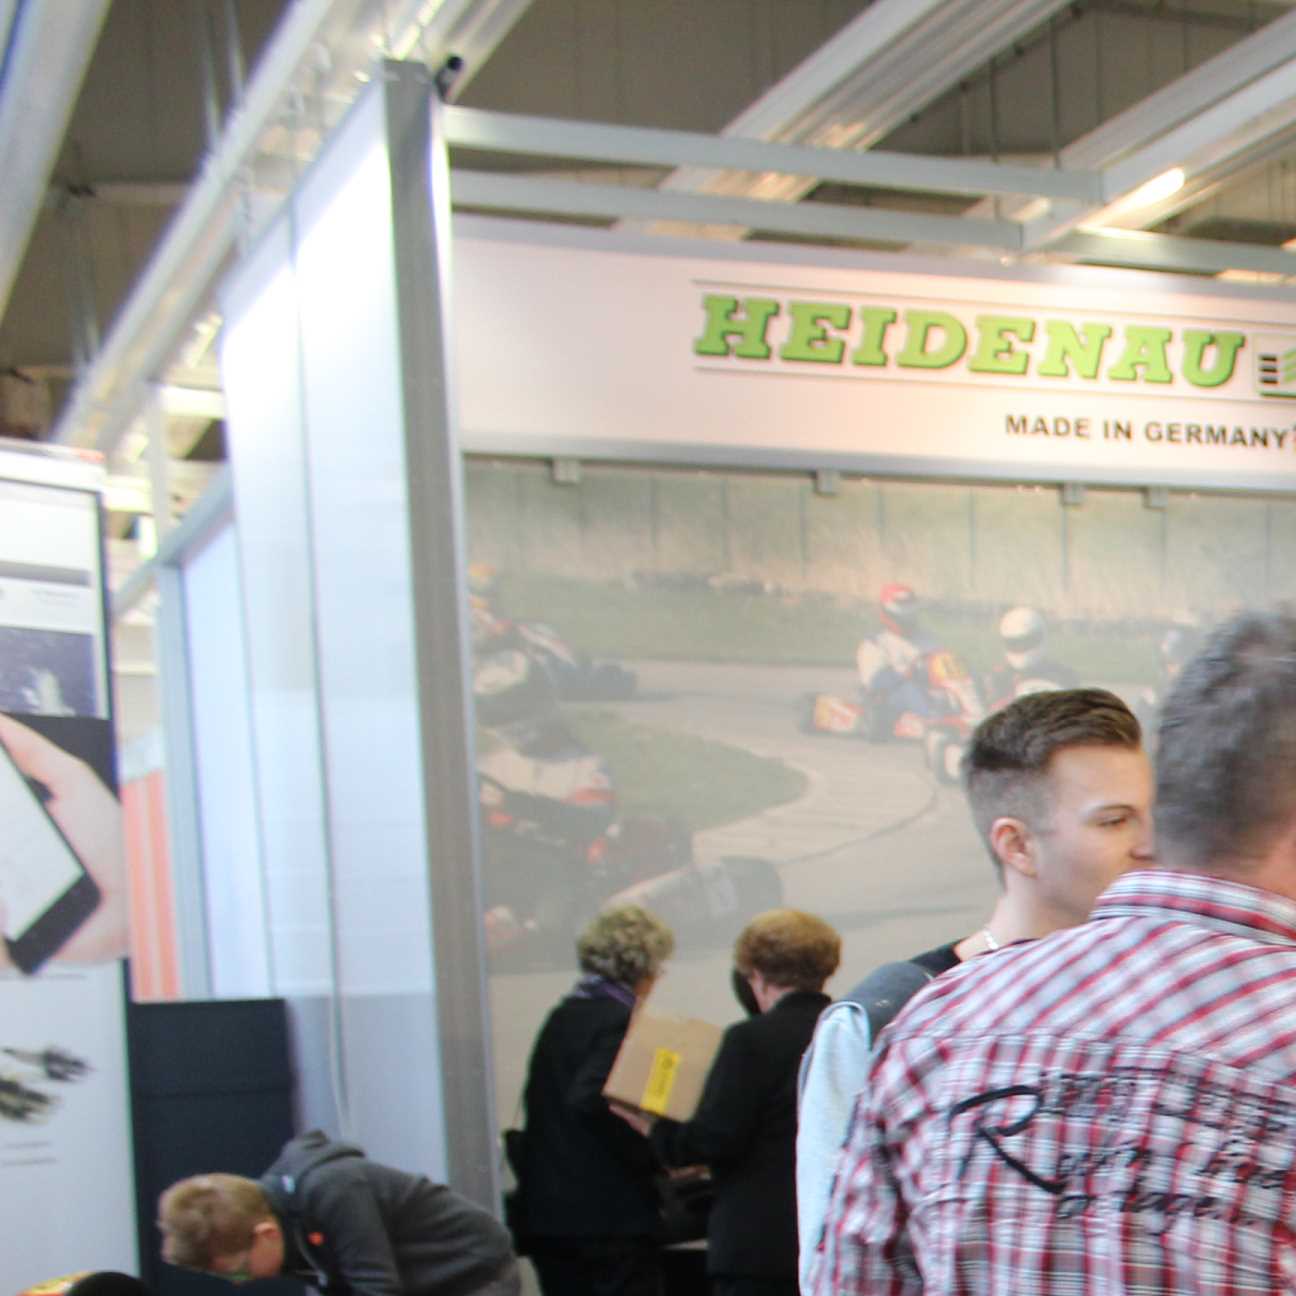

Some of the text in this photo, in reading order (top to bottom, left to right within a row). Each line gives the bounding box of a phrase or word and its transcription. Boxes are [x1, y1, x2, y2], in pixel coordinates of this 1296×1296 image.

[694, 294, 1247, 389] HEIDENAU
[1004, 414, 1288, 449] MADE IN GERMANY
